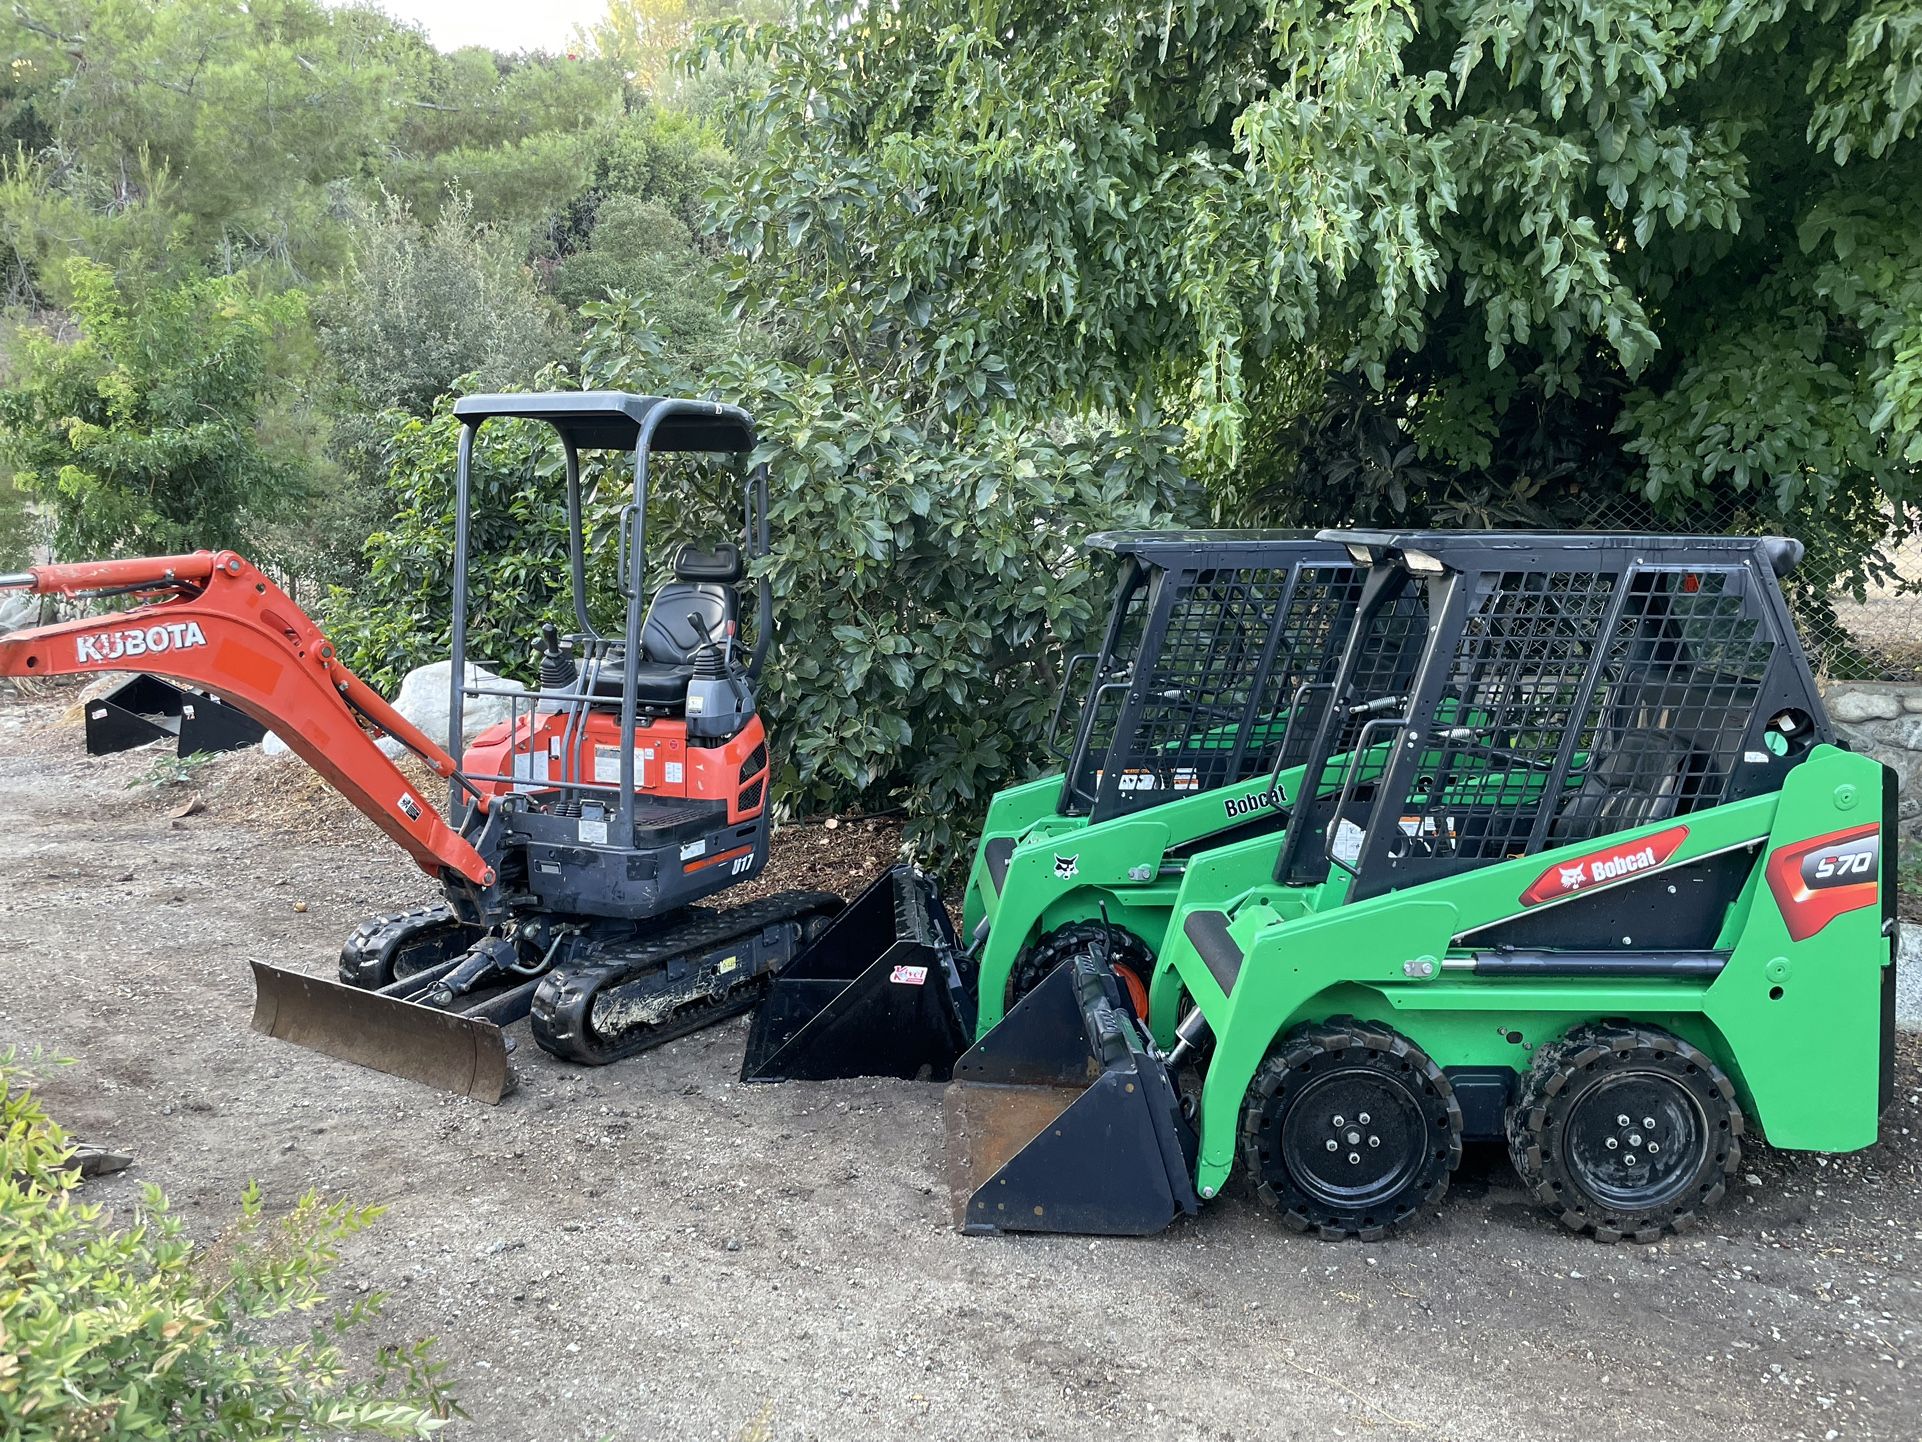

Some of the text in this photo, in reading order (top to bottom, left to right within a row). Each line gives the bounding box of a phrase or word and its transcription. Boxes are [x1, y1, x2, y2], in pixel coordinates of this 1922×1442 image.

[76, 622, 206, 662] KUBOTA
[1223, 784, 1288, 819] Bobcat
[732, 853, 755, 875] U17
[1591, 847, 1656, 882] Bobcat
[1815, 851, 1873, 878] S70
